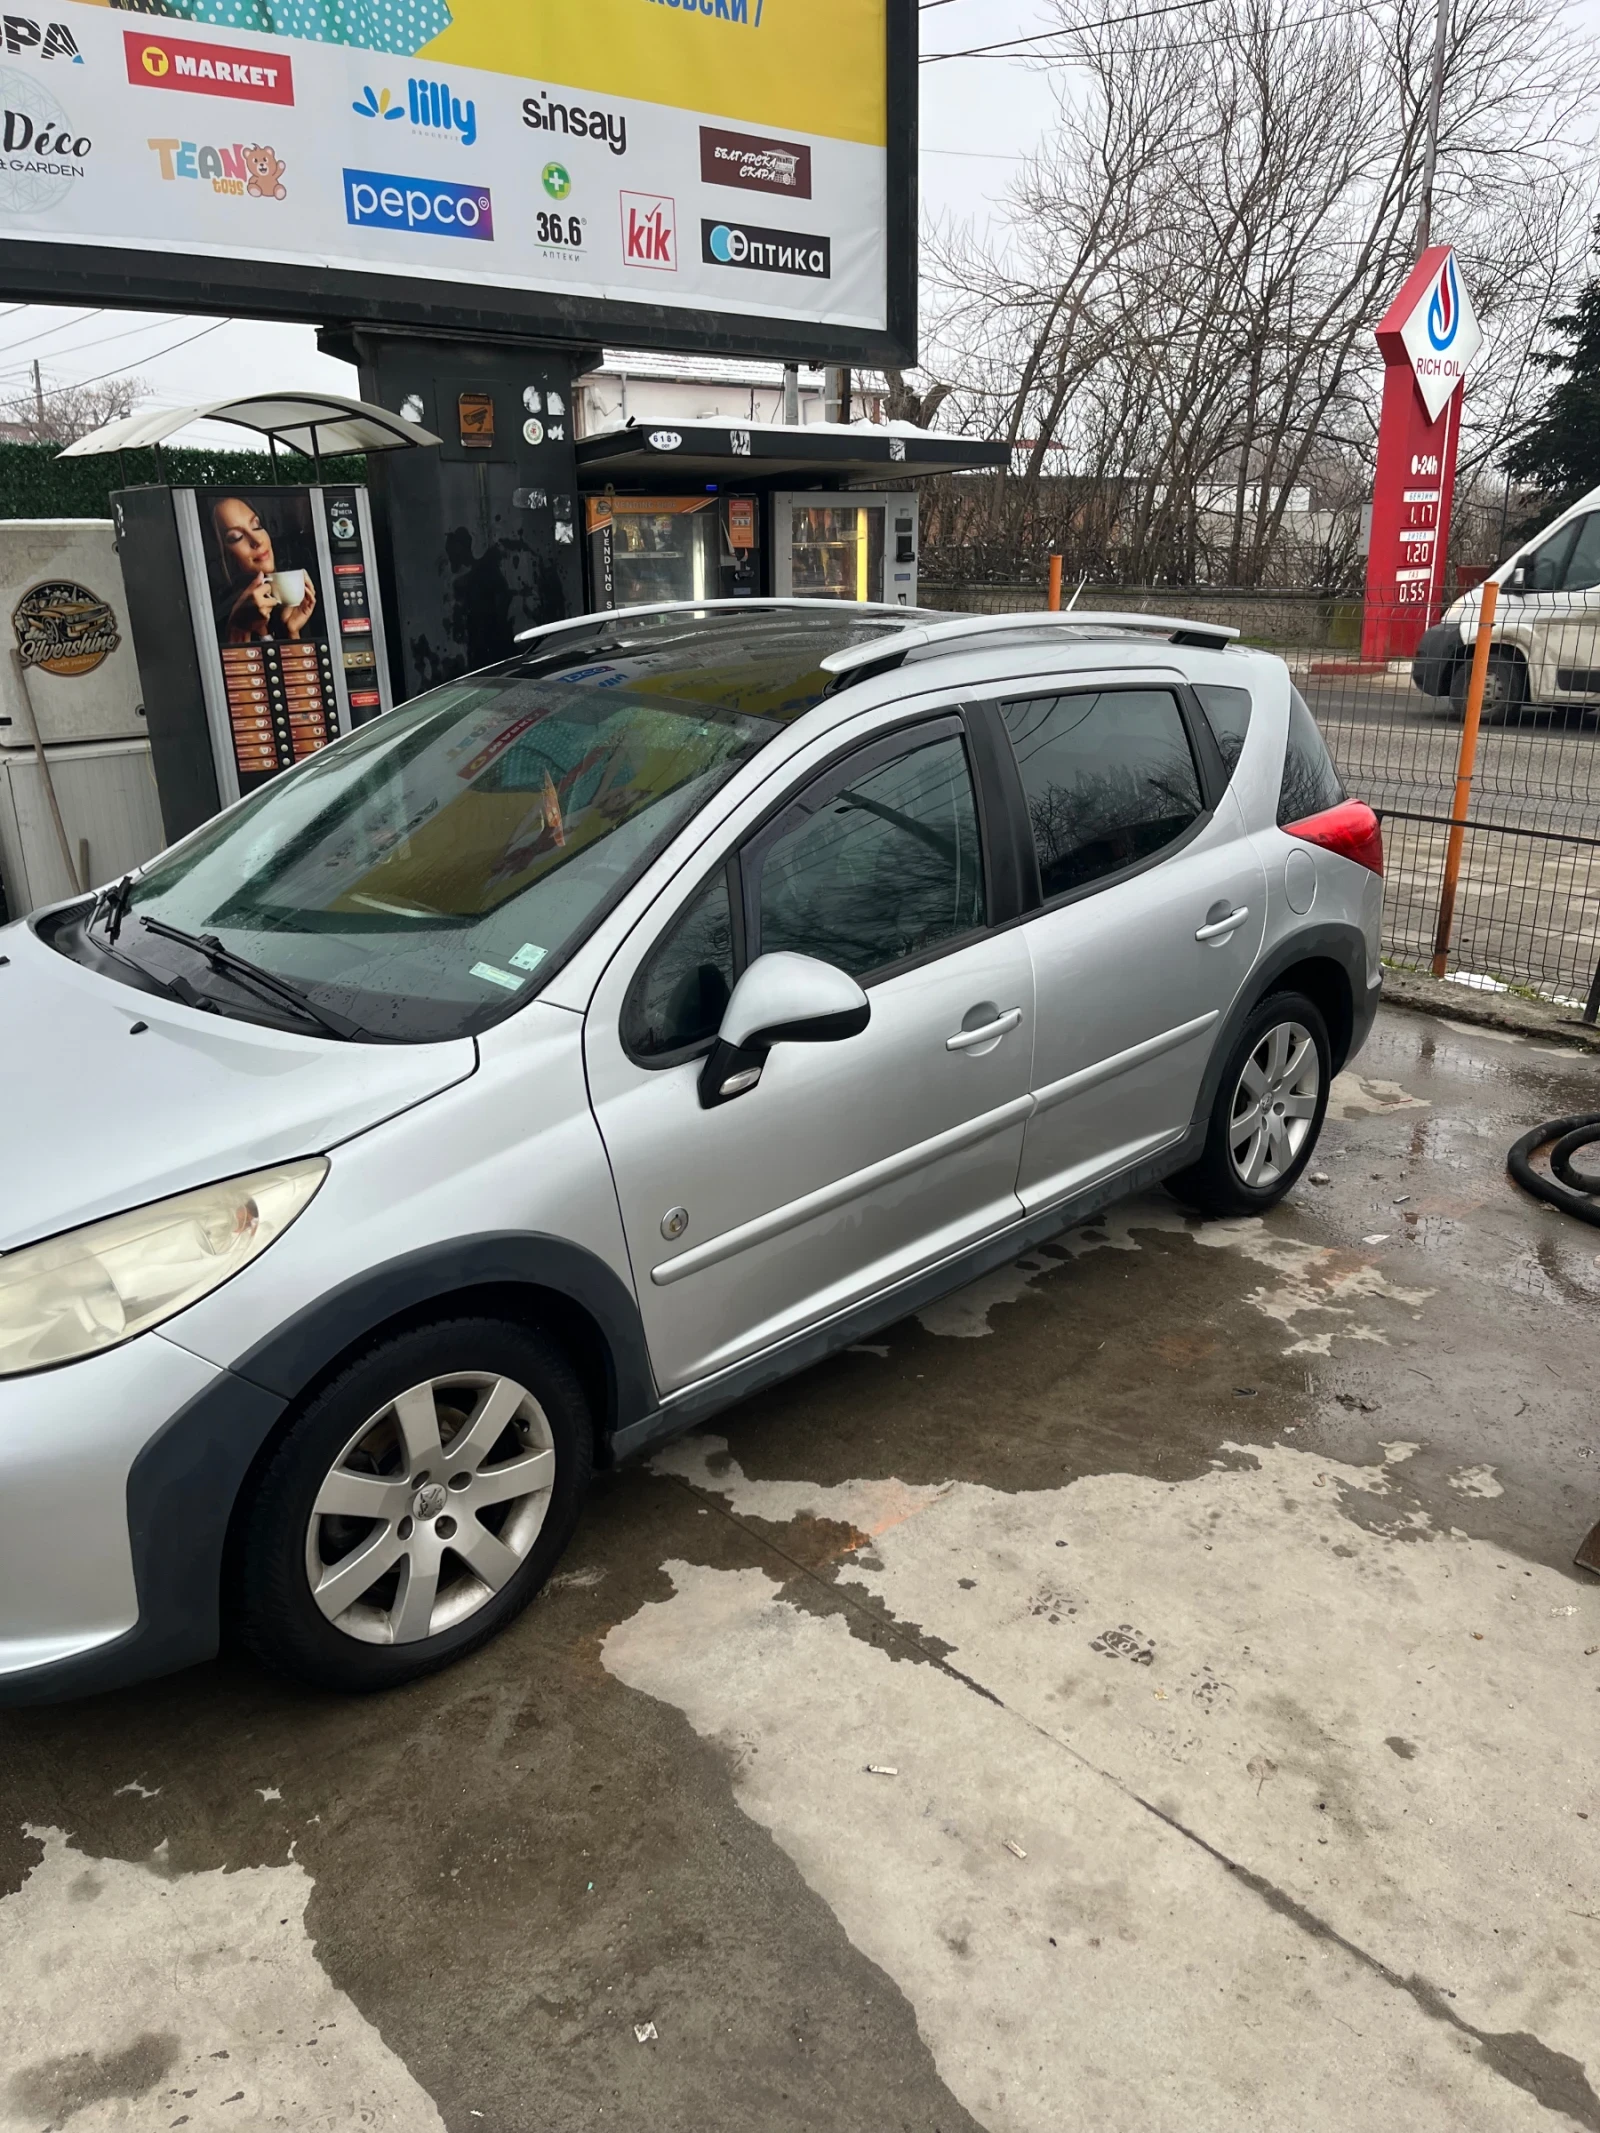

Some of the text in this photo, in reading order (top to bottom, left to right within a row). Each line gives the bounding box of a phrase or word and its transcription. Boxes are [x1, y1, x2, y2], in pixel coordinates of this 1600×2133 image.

[174, 54, 278, 88] MARKET
[408, 78, 477, 146] lilly
[3, 109, 92, 157] Déco
[522, 91, 627, 156] sinsay
[147, 138, 247, 182] TEAN
[714, 146, 777, 168] БЪЛГАРСКА
[9, 159, 84, 178] GARDEN
[739, 165, 776, 180] СКАРА
[212, 177, 245, 196] toys
[351, 183, 480, 227] pepco
[627, 202, 672, 262] kik
[542, 250, 580, 262] АПТЕКИ
[1416, 357, 1462, 377] RICH OIL
[653, 434, 678, 443] 6181
[1411, 454, 1438, 476] 0-24h
[1409, 492, 1434, 501] БЕНЗИН
[1410, 504, 1433, 524] 1.17
[1407, 531, 1427, 541] ДИЗЕЛ
[1406, 543, 1429, 563] 1.20
[603, 529, 613, 609] VENDING S
[1408, 569, 1419, 578] ГАЗ
[1399, 582, 1425, 603] 0.55
[20, 632, 116, 667] Silvershine
